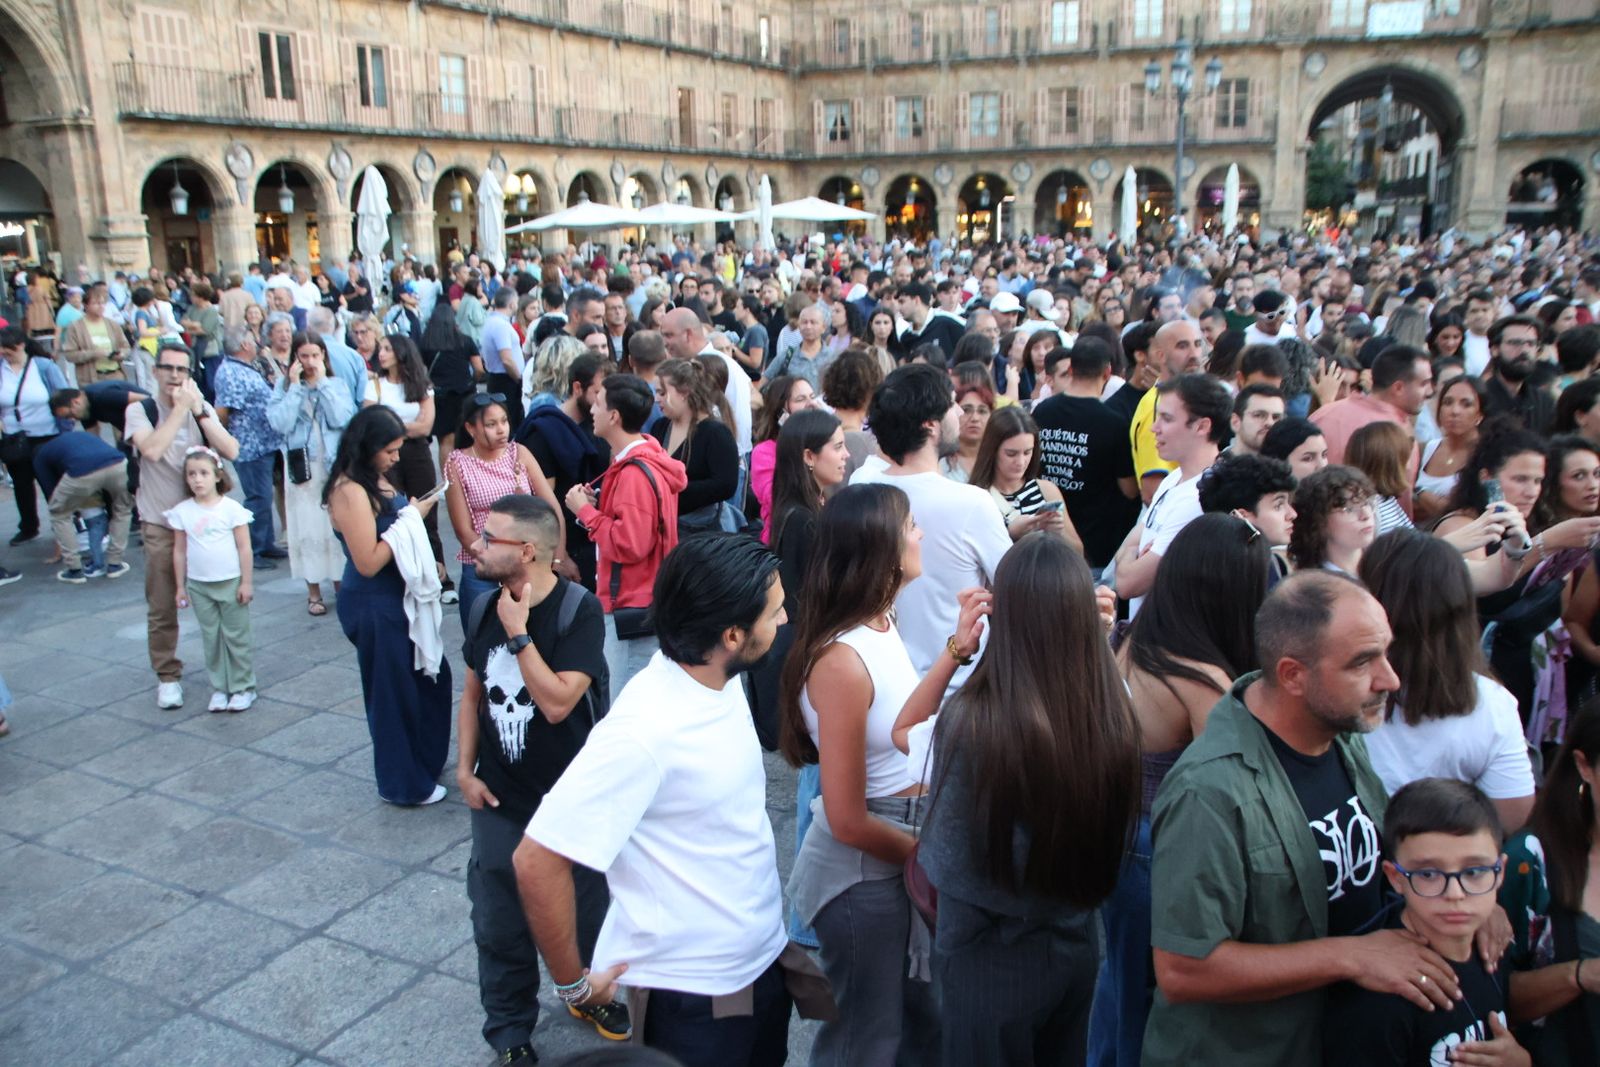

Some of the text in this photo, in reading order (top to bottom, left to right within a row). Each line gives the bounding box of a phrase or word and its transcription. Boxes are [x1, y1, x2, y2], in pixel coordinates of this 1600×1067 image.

[1062, 430, 1077, 442] TAL
[1078, 433, 1089, 444] SI
[1040, 452, 1046, 462] A
[1074, 458, 1082, 468] A
